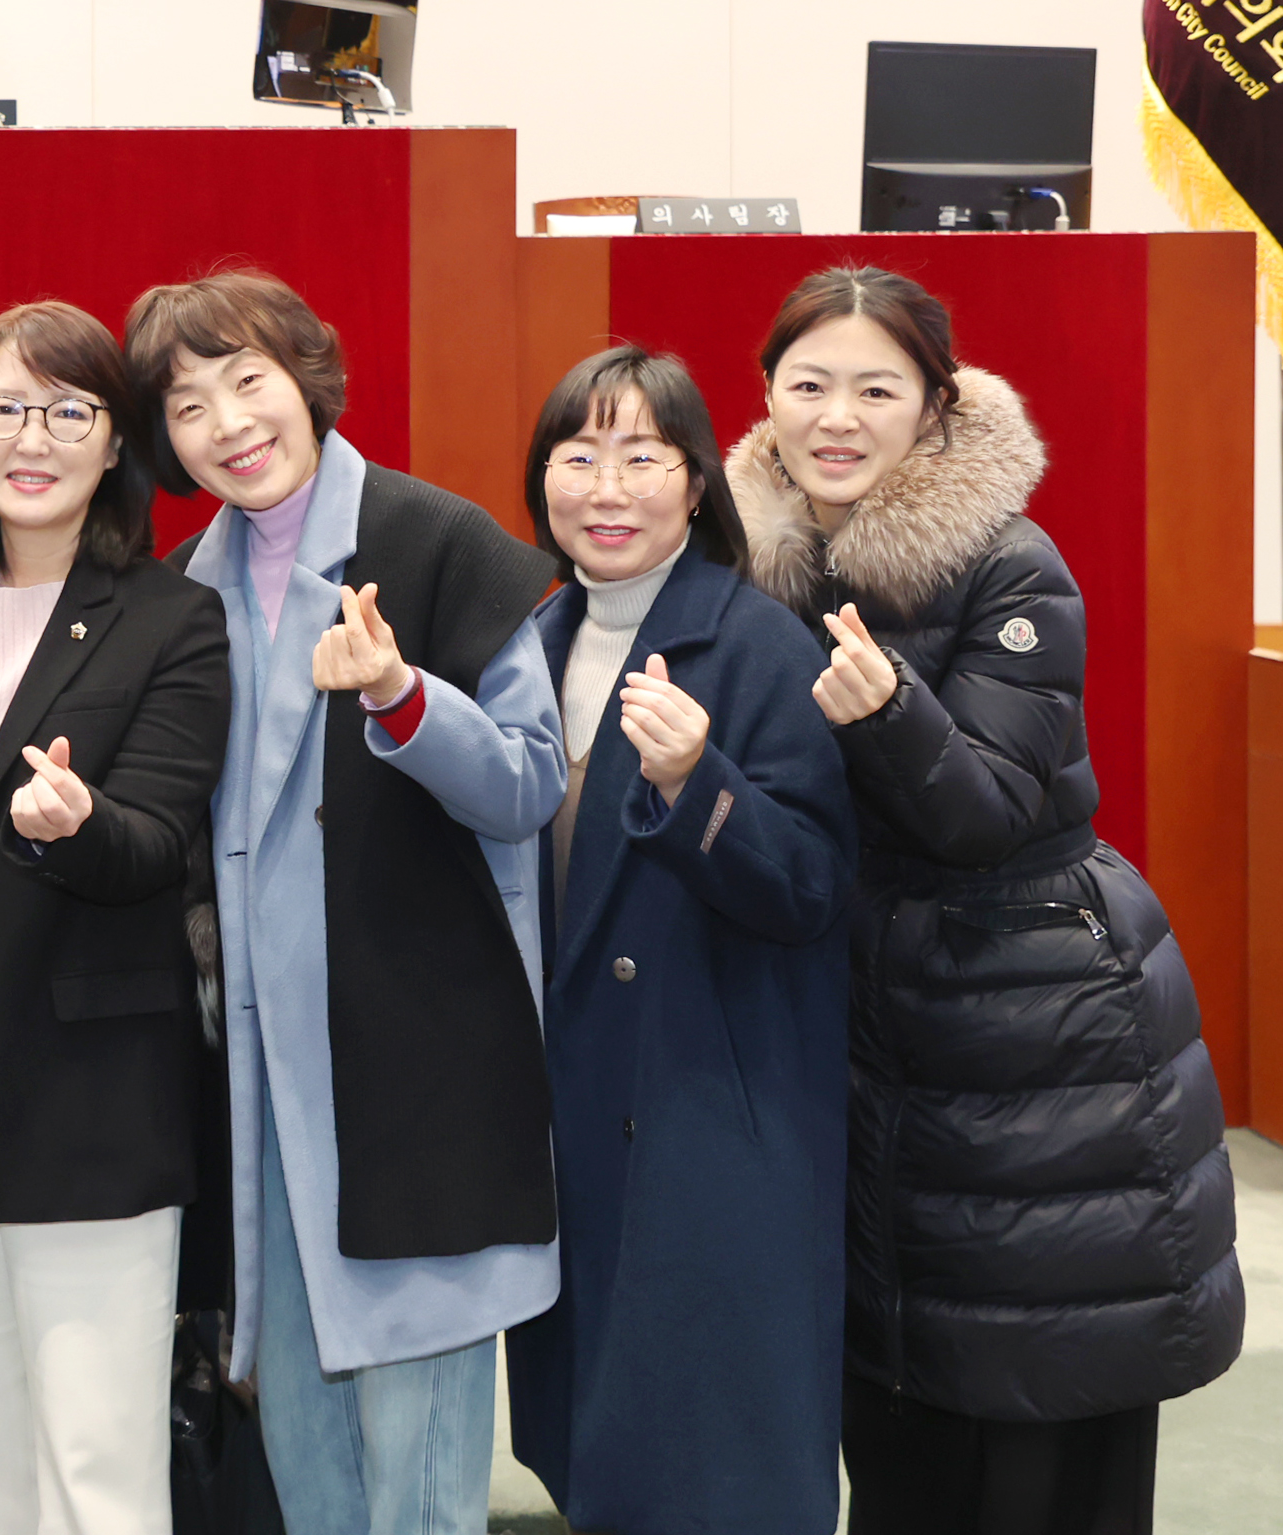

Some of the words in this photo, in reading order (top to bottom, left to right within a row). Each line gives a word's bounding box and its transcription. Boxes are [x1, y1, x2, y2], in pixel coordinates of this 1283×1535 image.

[1176, 2, 1209, 40] City
[1204, 34, 1269, 100] Council
[651, 203, 790, 227] 의사팀장
